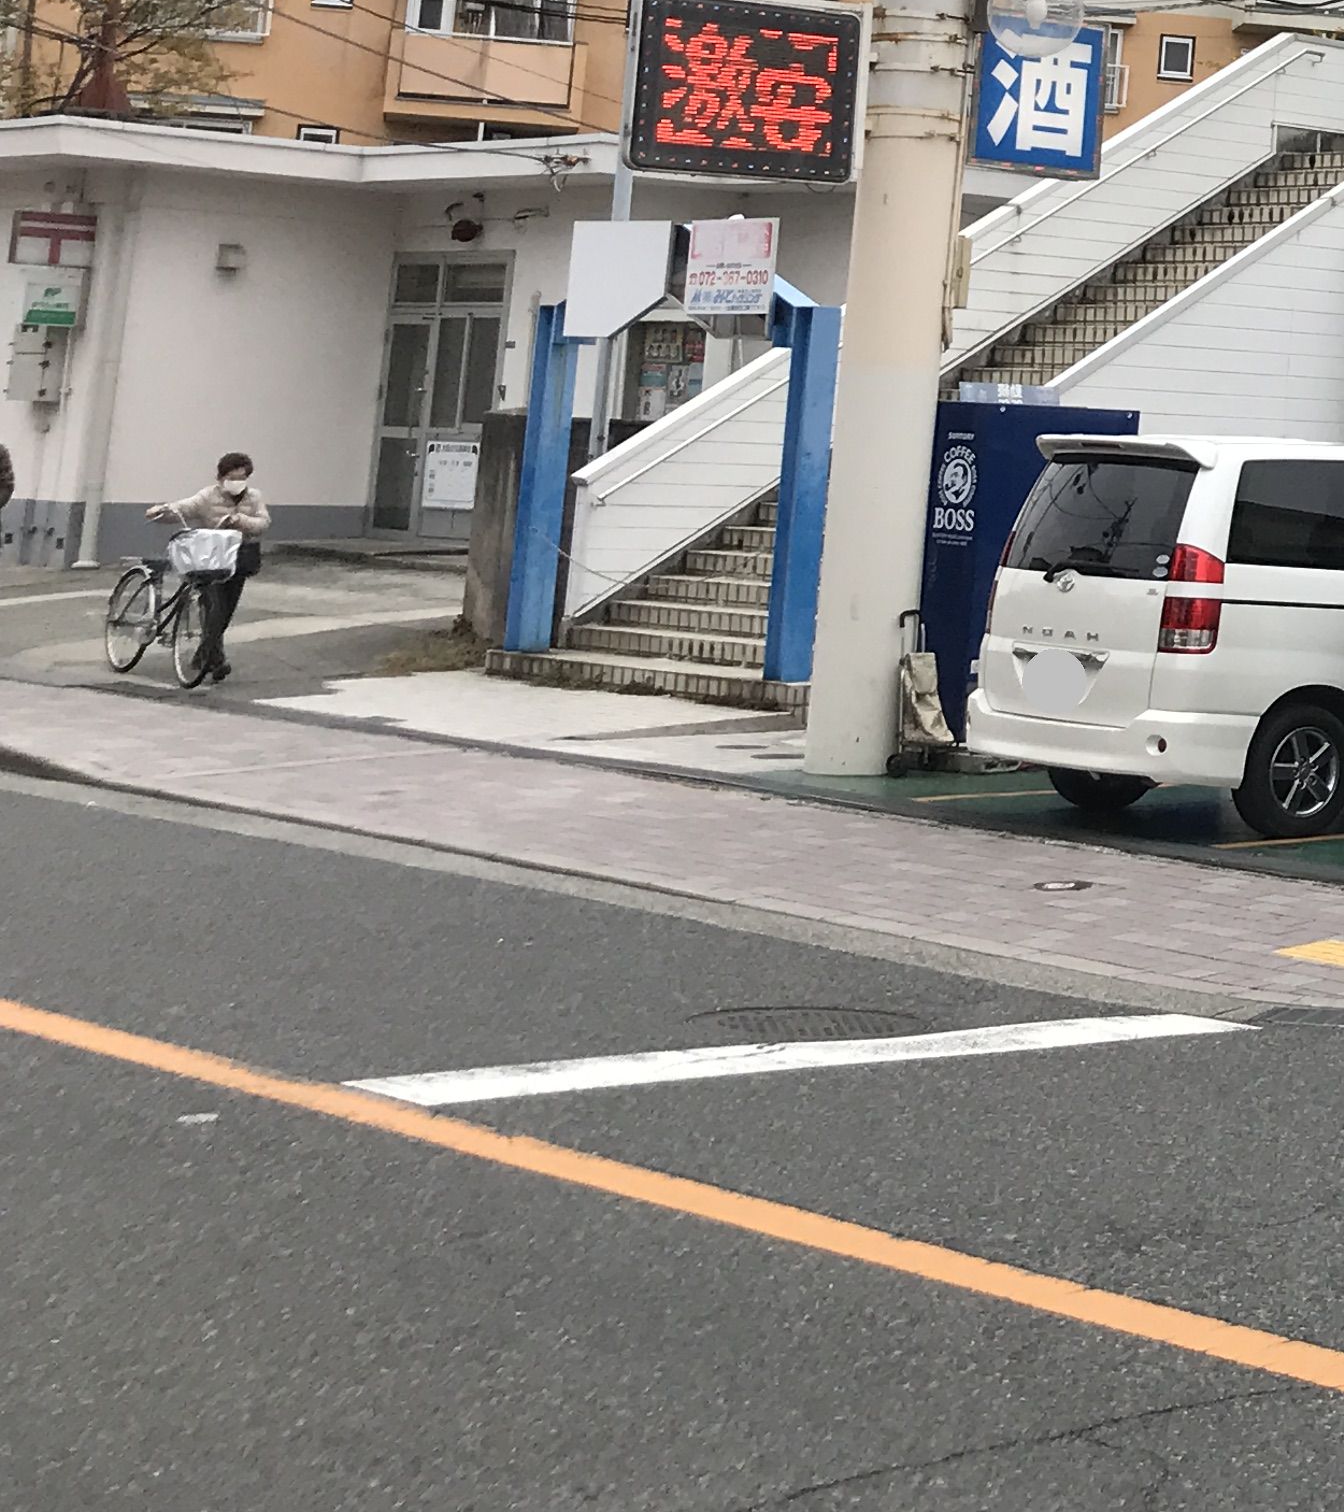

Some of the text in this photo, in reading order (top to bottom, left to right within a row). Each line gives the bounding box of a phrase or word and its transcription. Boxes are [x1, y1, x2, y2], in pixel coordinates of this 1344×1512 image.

[986, 31, 1092, 157] 酒
[943, 444, 977, 465] COFFEE
[932, 507, 975, 532] BOSS
[1022, 626, 1100, 642] NOAH
